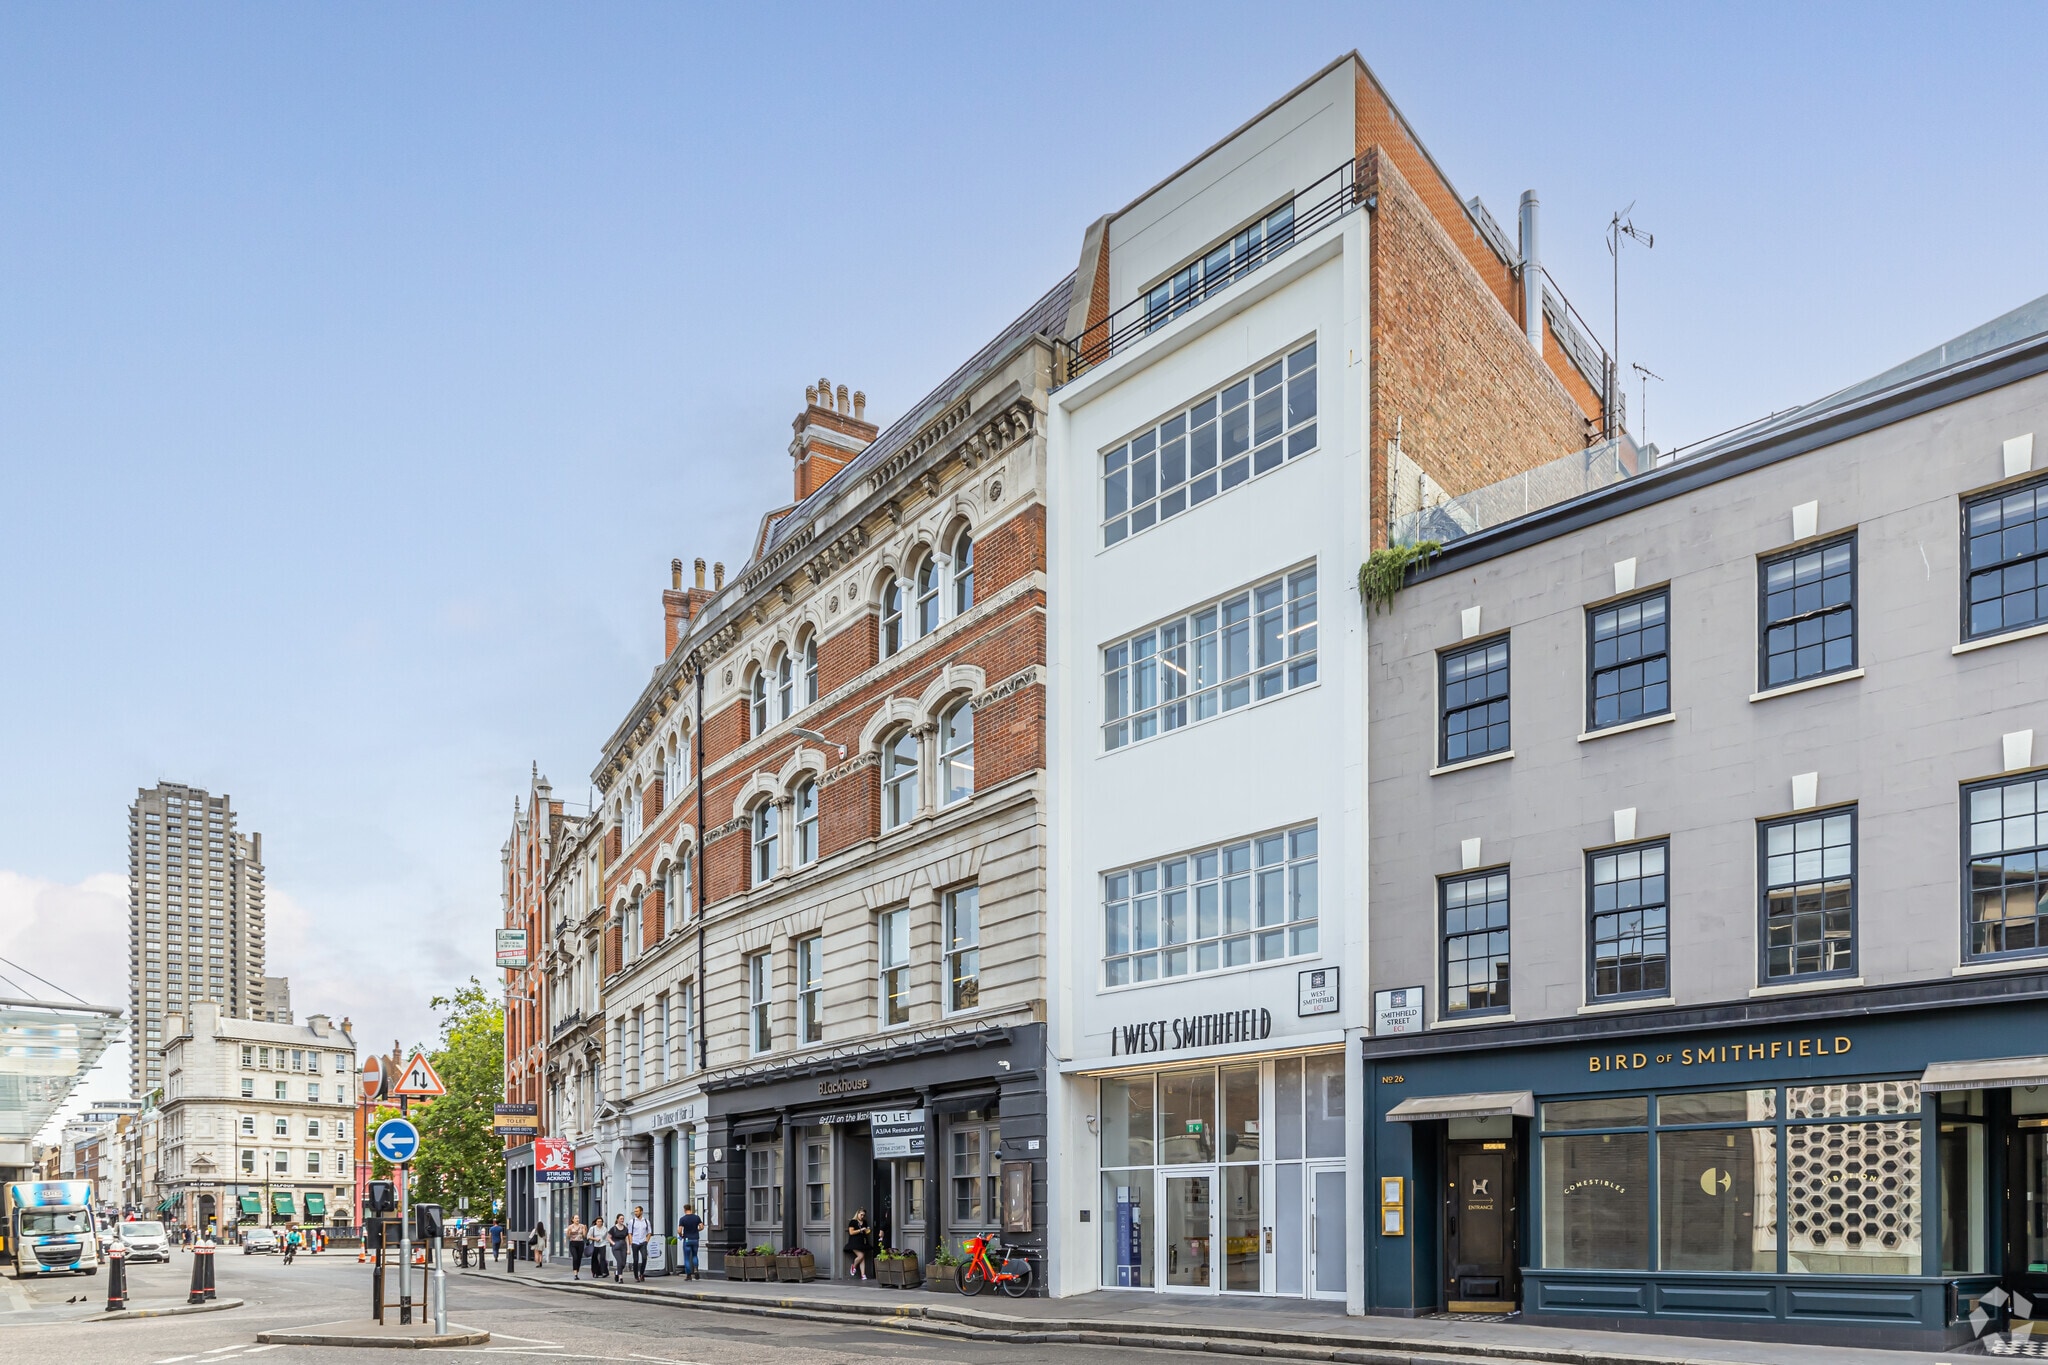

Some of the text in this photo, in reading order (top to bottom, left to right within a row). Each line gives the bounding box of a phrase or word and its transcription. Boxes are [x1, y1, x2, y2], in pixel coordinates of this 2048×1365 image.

[1311, 990, 1326, 998] WEST
[1303, 996, 1335, 1006] SMITHFIELD
[1381, 1009, 1418, 1019] SMITHFIELD
[1387, 1017, 1410, 1026] STREET
[1122, 1020, 1167, 1055] WEST
[1172, 1007, 1272, 1050] SMITHFIELD
[1588, 1036, 1852, 1072] BIRD OF SMITHFIELD
[1394, 1075, 1404, 1083] 26
[818, 1078, 868, 1095] Blackhouse
[819, 1114, 835, 1125] Grill
[845, 1113, 856, 1122] the
[857, 1110, 872, 1121] Mark
[874, 1112, 912, 1123] TO LET
[892, 1126, 918, 1134] Restaurant
[1564, 1179, 1626, 1194] COMESTIBLES
